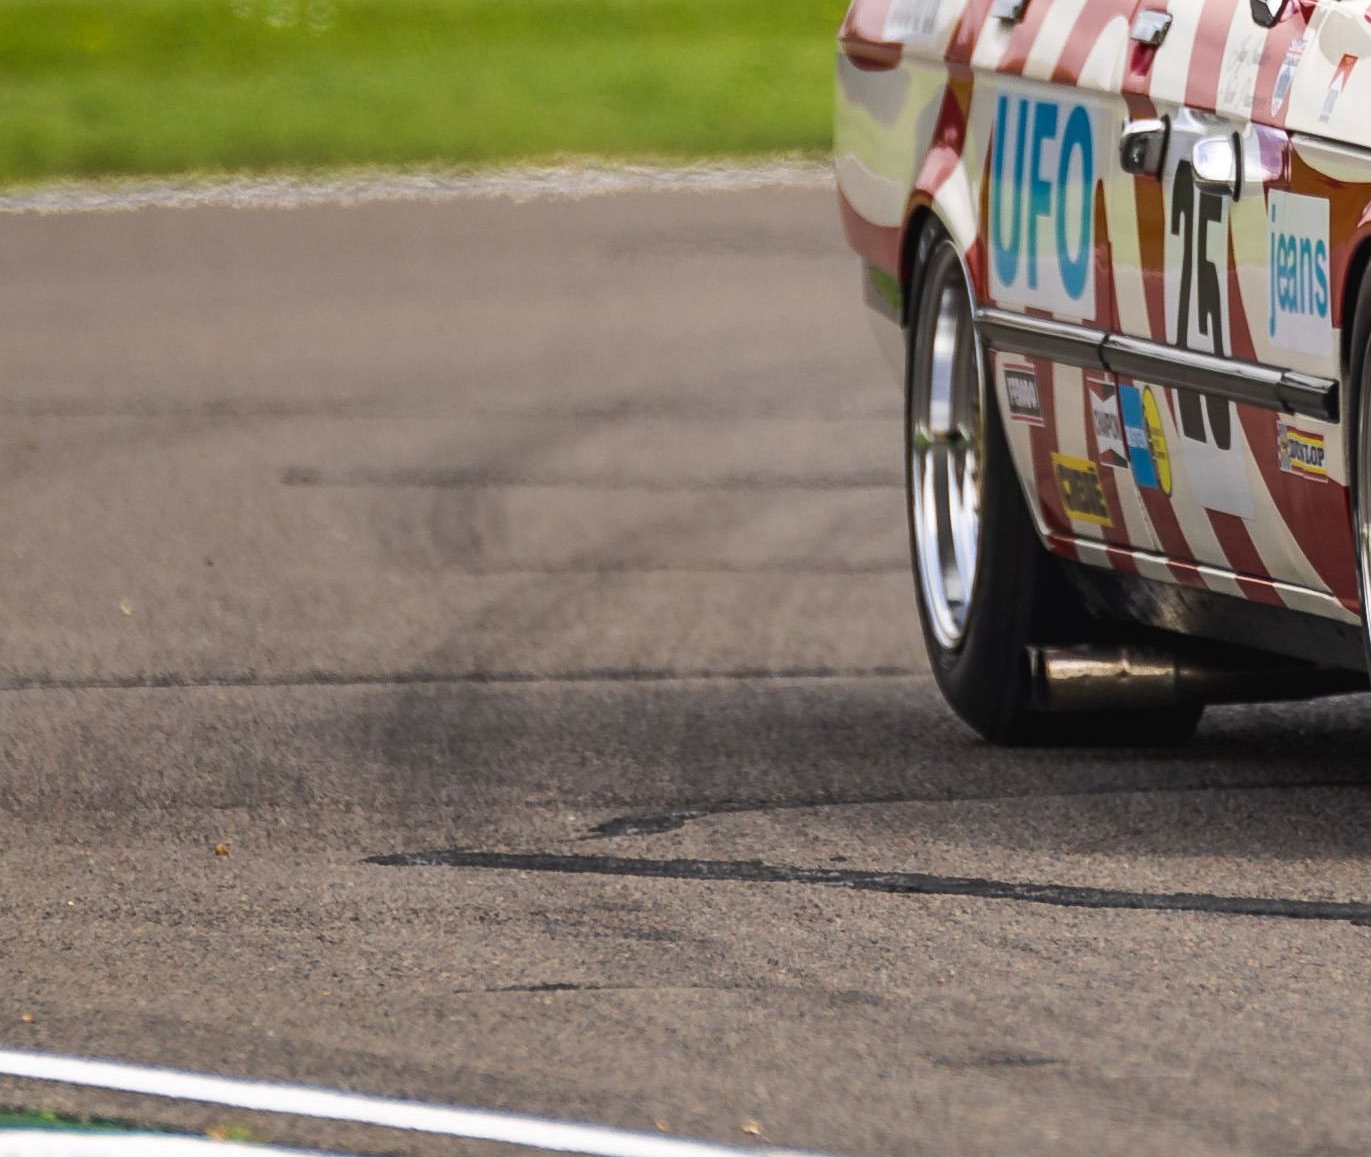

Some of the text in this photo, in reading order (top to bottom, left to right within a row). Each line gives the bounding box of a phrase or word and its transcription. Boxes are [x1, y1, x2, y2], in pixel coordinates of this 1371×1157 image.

[990, 95, 1094, 300] UFO
[1268, 203, 1328, 338] jeans
[1171, 158, 1231, 450] 25
[1288, 438, 1325, 467] DUNLOP
